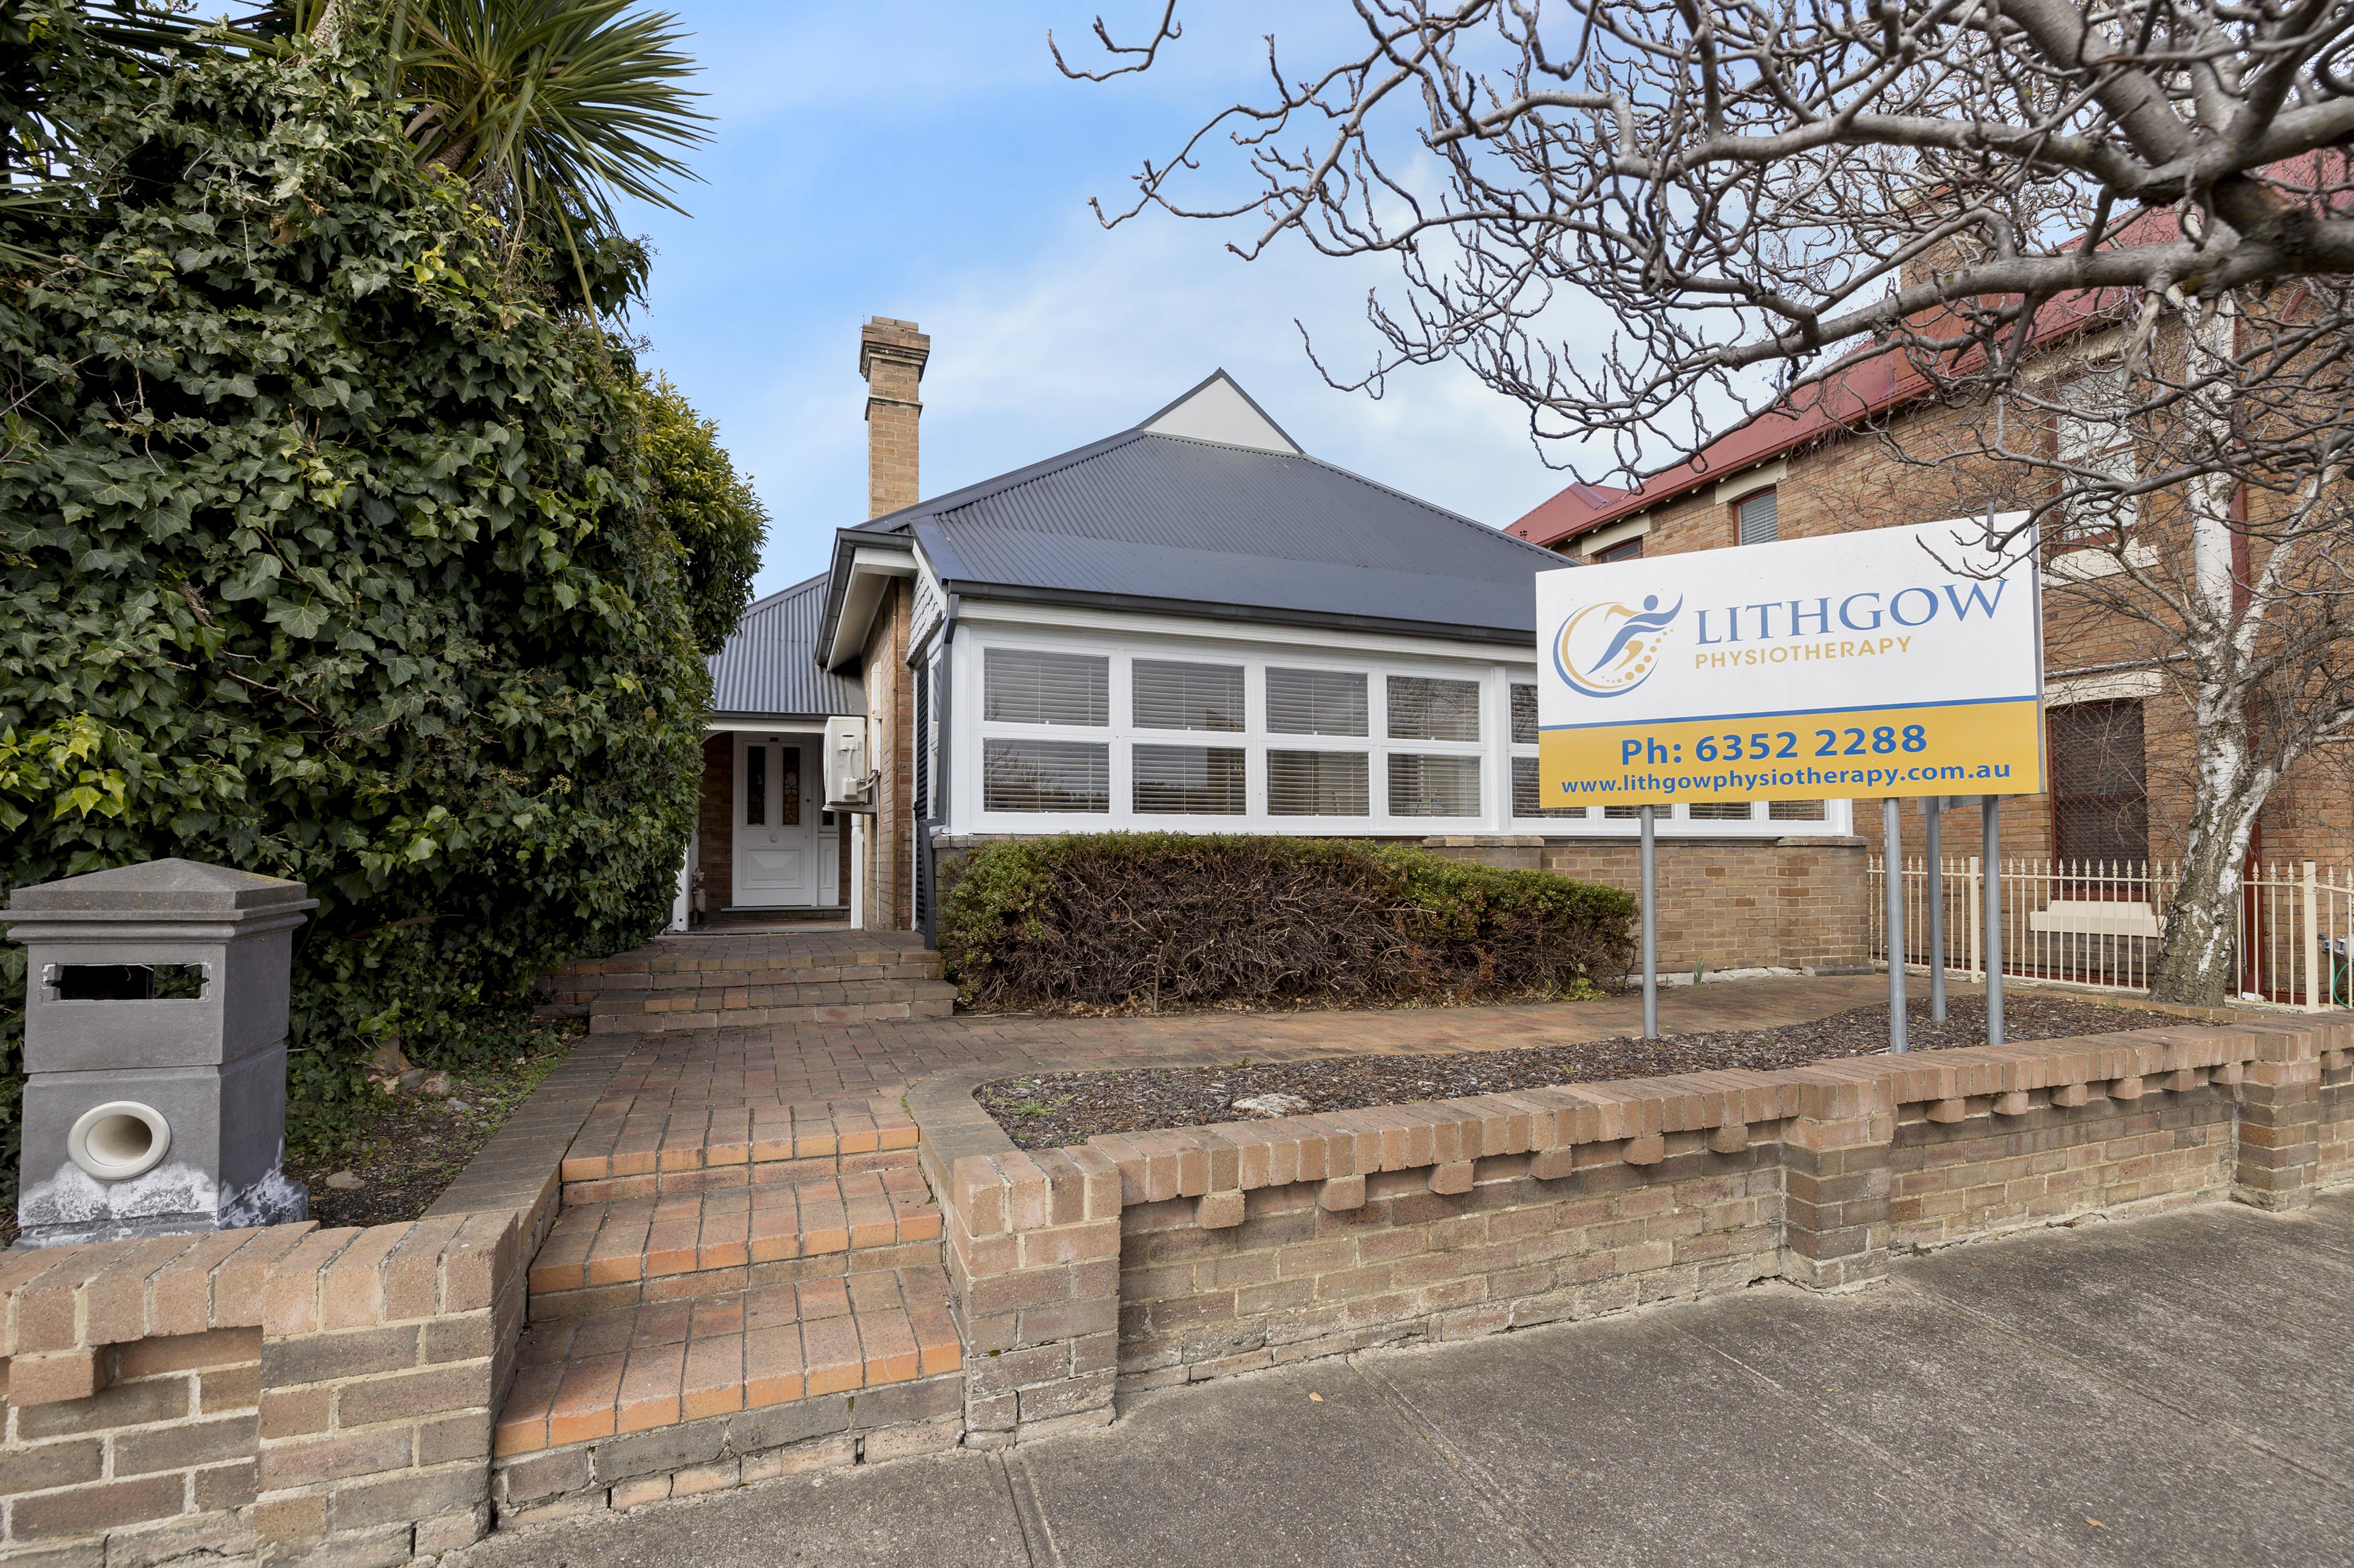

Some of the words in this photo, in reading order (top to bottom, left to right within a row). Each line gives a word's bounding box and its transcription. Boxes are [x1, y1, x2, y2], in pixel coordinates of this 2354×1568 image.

[1694, 579, 2011, 646] LITHGOW
[1695, 635, 1912, 670] PHYSIOTHERAPY
[1622, 737, 1682, 766] Ph:
[1695, 731, 1798, 762] 6352
[1815, 724, 1927, 757] 2288
[1561, 764, 2011, 794] www.lithgowphysiotherapy.com.au
